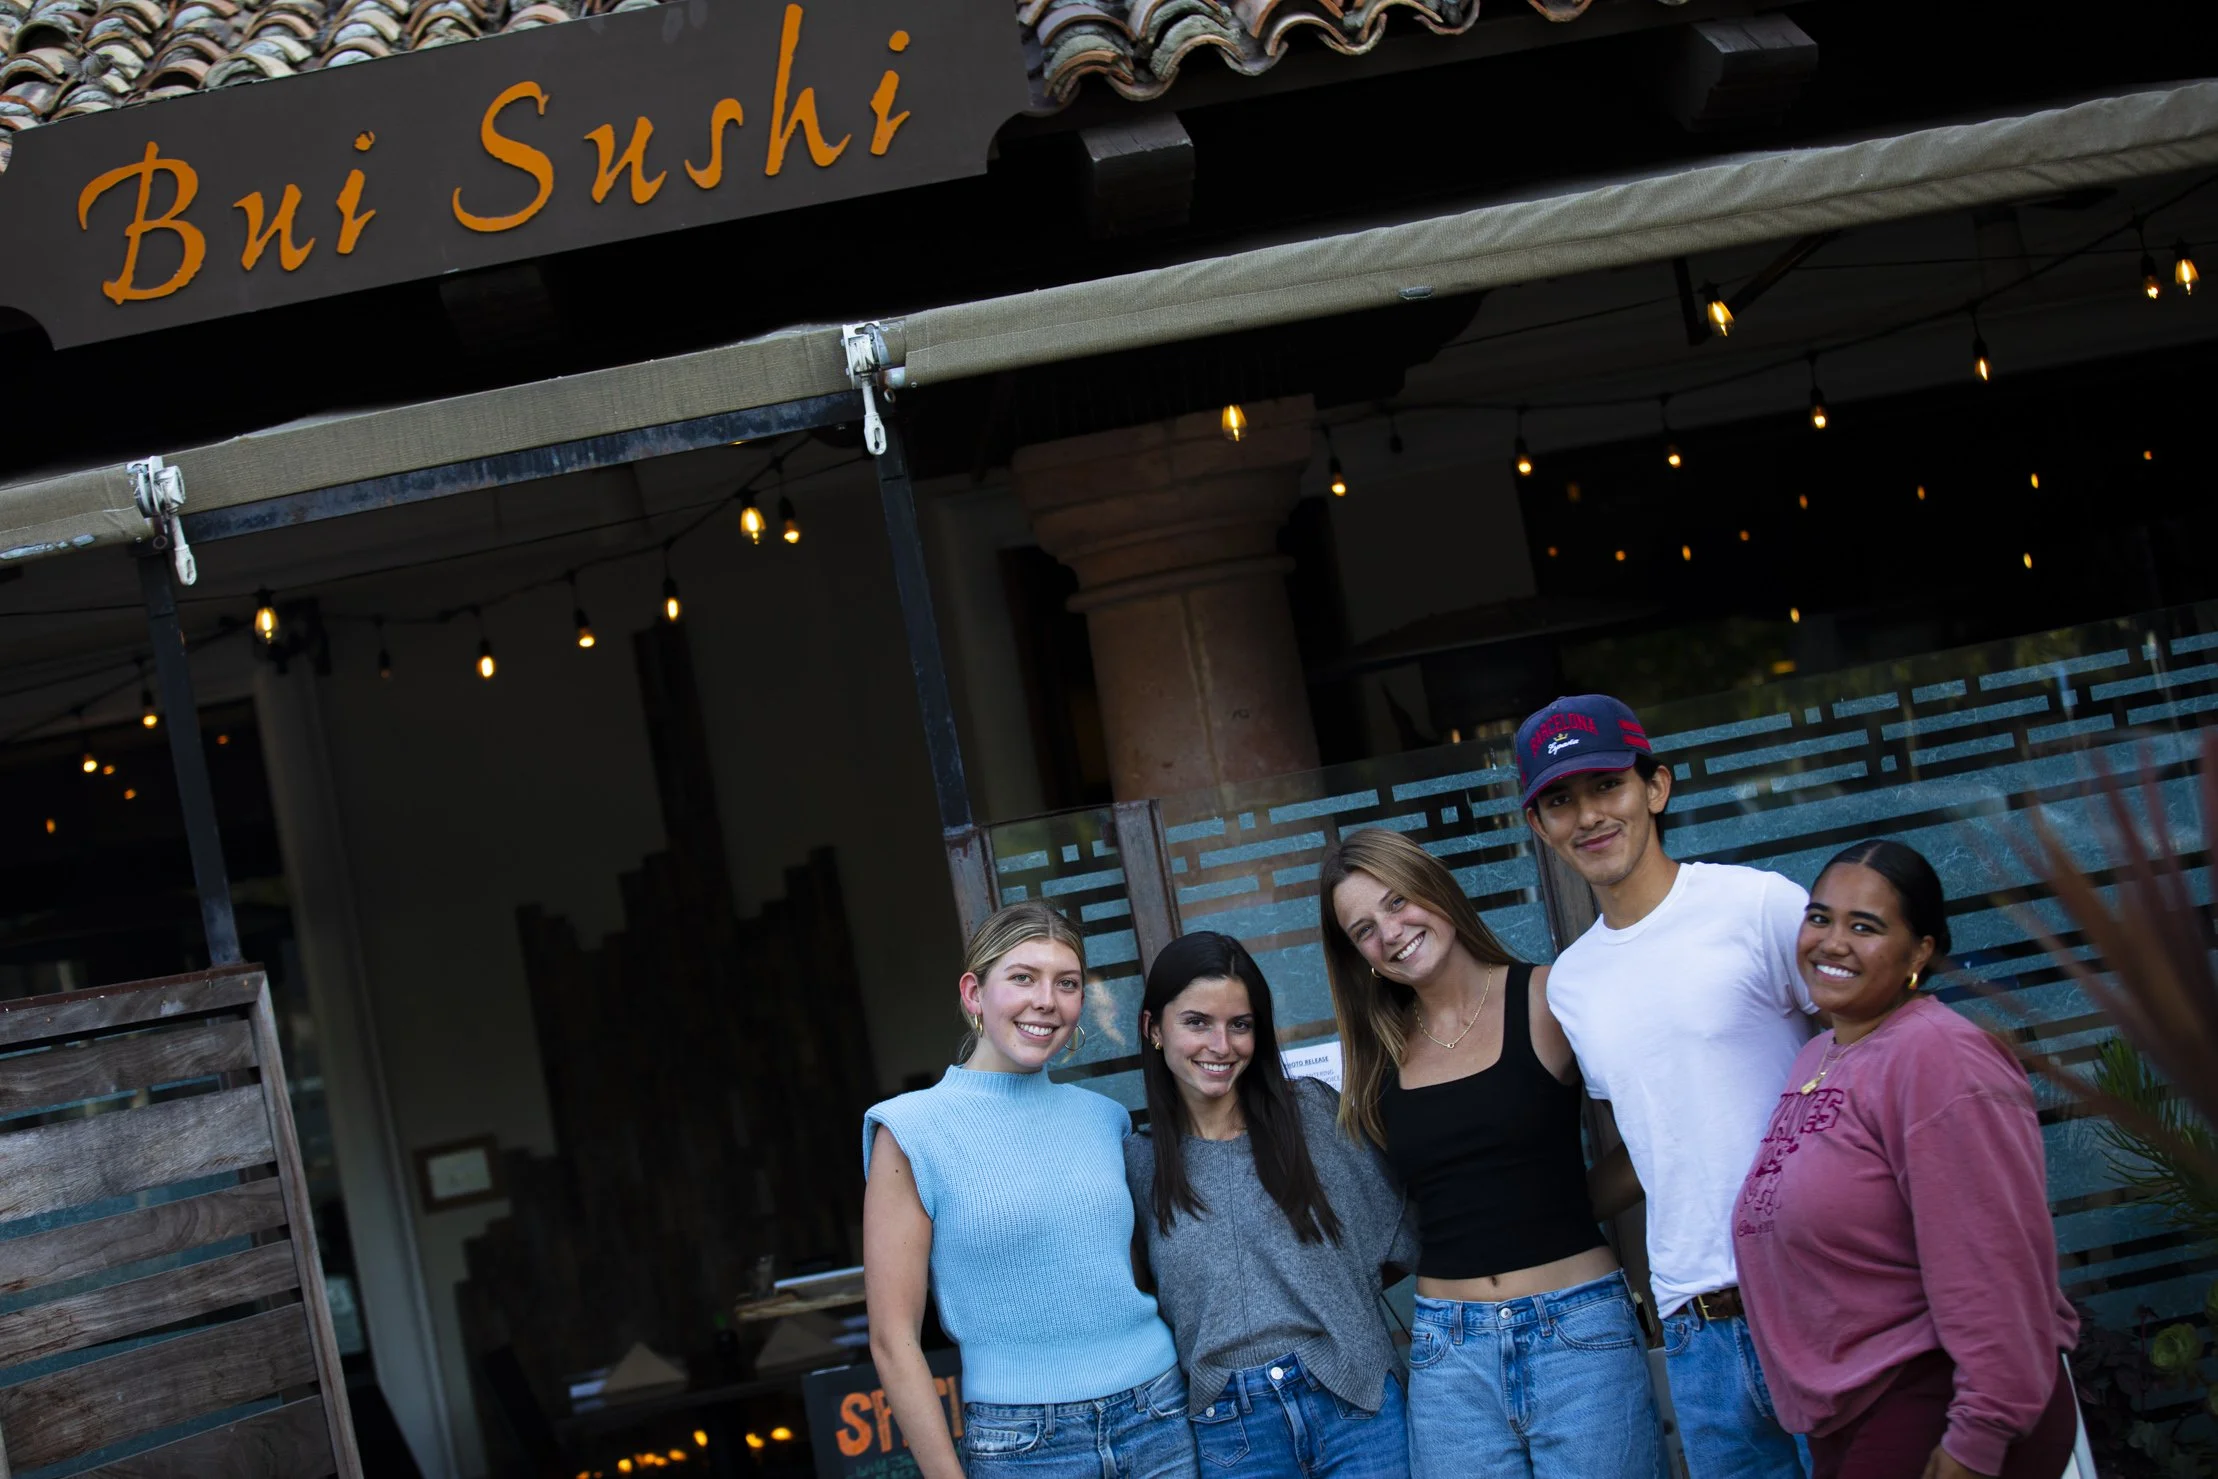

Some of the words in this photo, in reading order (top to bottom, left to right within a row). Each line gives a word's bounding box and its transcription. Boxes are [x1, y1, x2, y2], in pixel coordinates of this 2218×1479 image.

[78, 133, 375, 304] Bui
[453, 4, 909, 231] Sushi
[1529, 712, 1599, 758] BARCELONA
[1305, 1056, 1328, 1065] RELEASE
